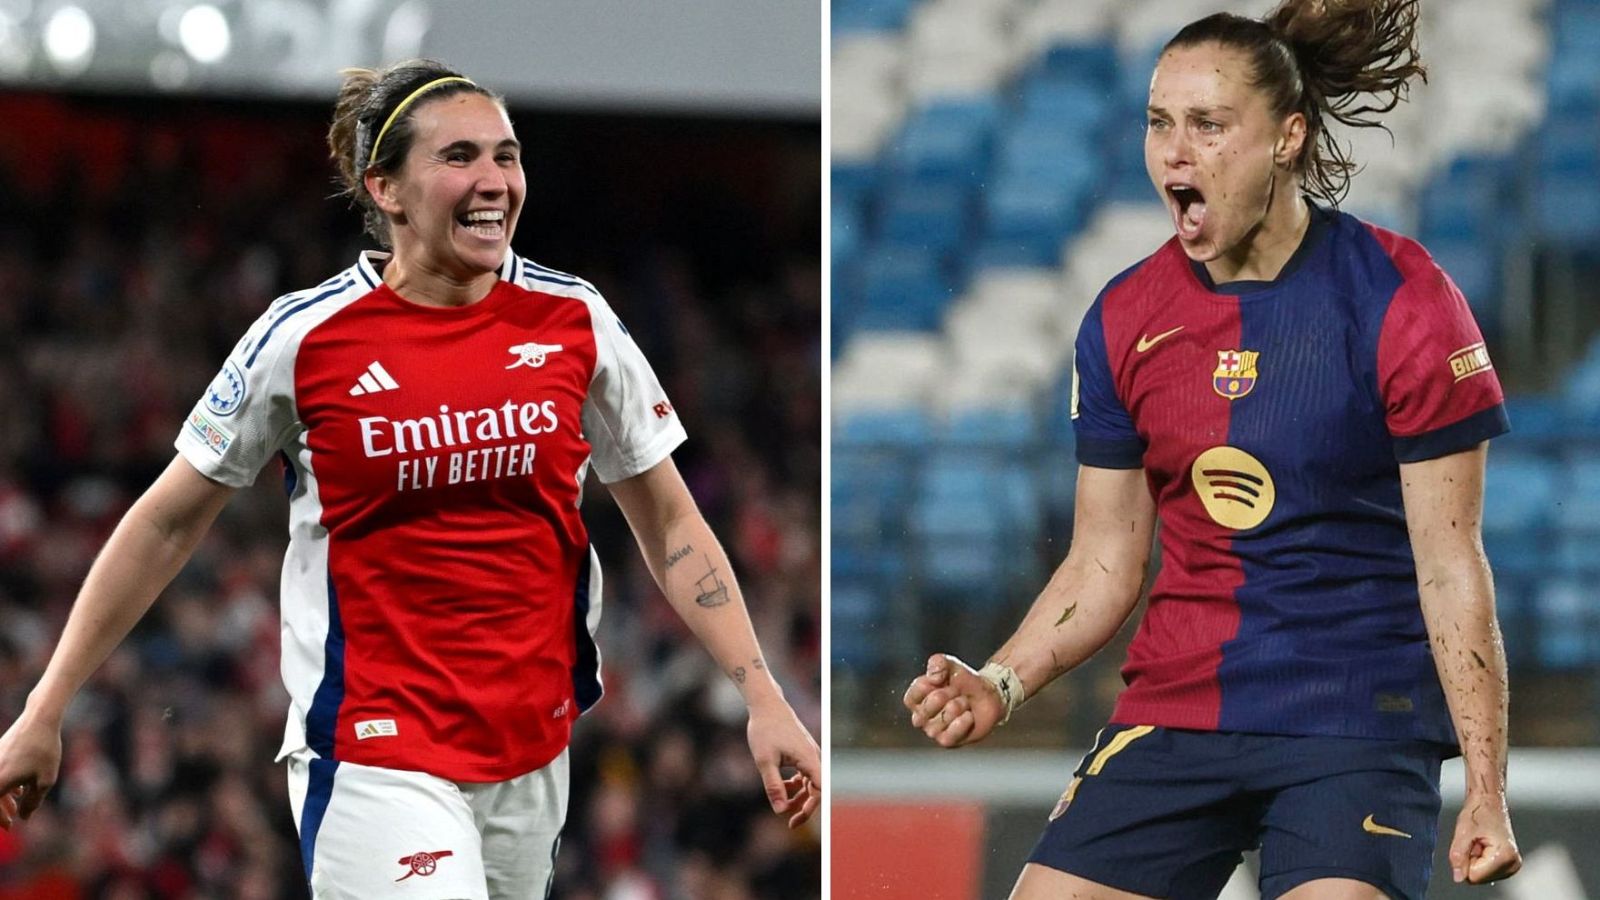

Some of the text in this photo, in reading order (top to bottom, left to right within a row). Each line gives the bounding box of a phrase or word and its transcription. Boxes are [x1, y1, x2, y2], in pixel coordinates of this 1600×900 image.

[358, 399, 558, 458] Emirates
[397, 443, 536, 491] FLY BETTER
